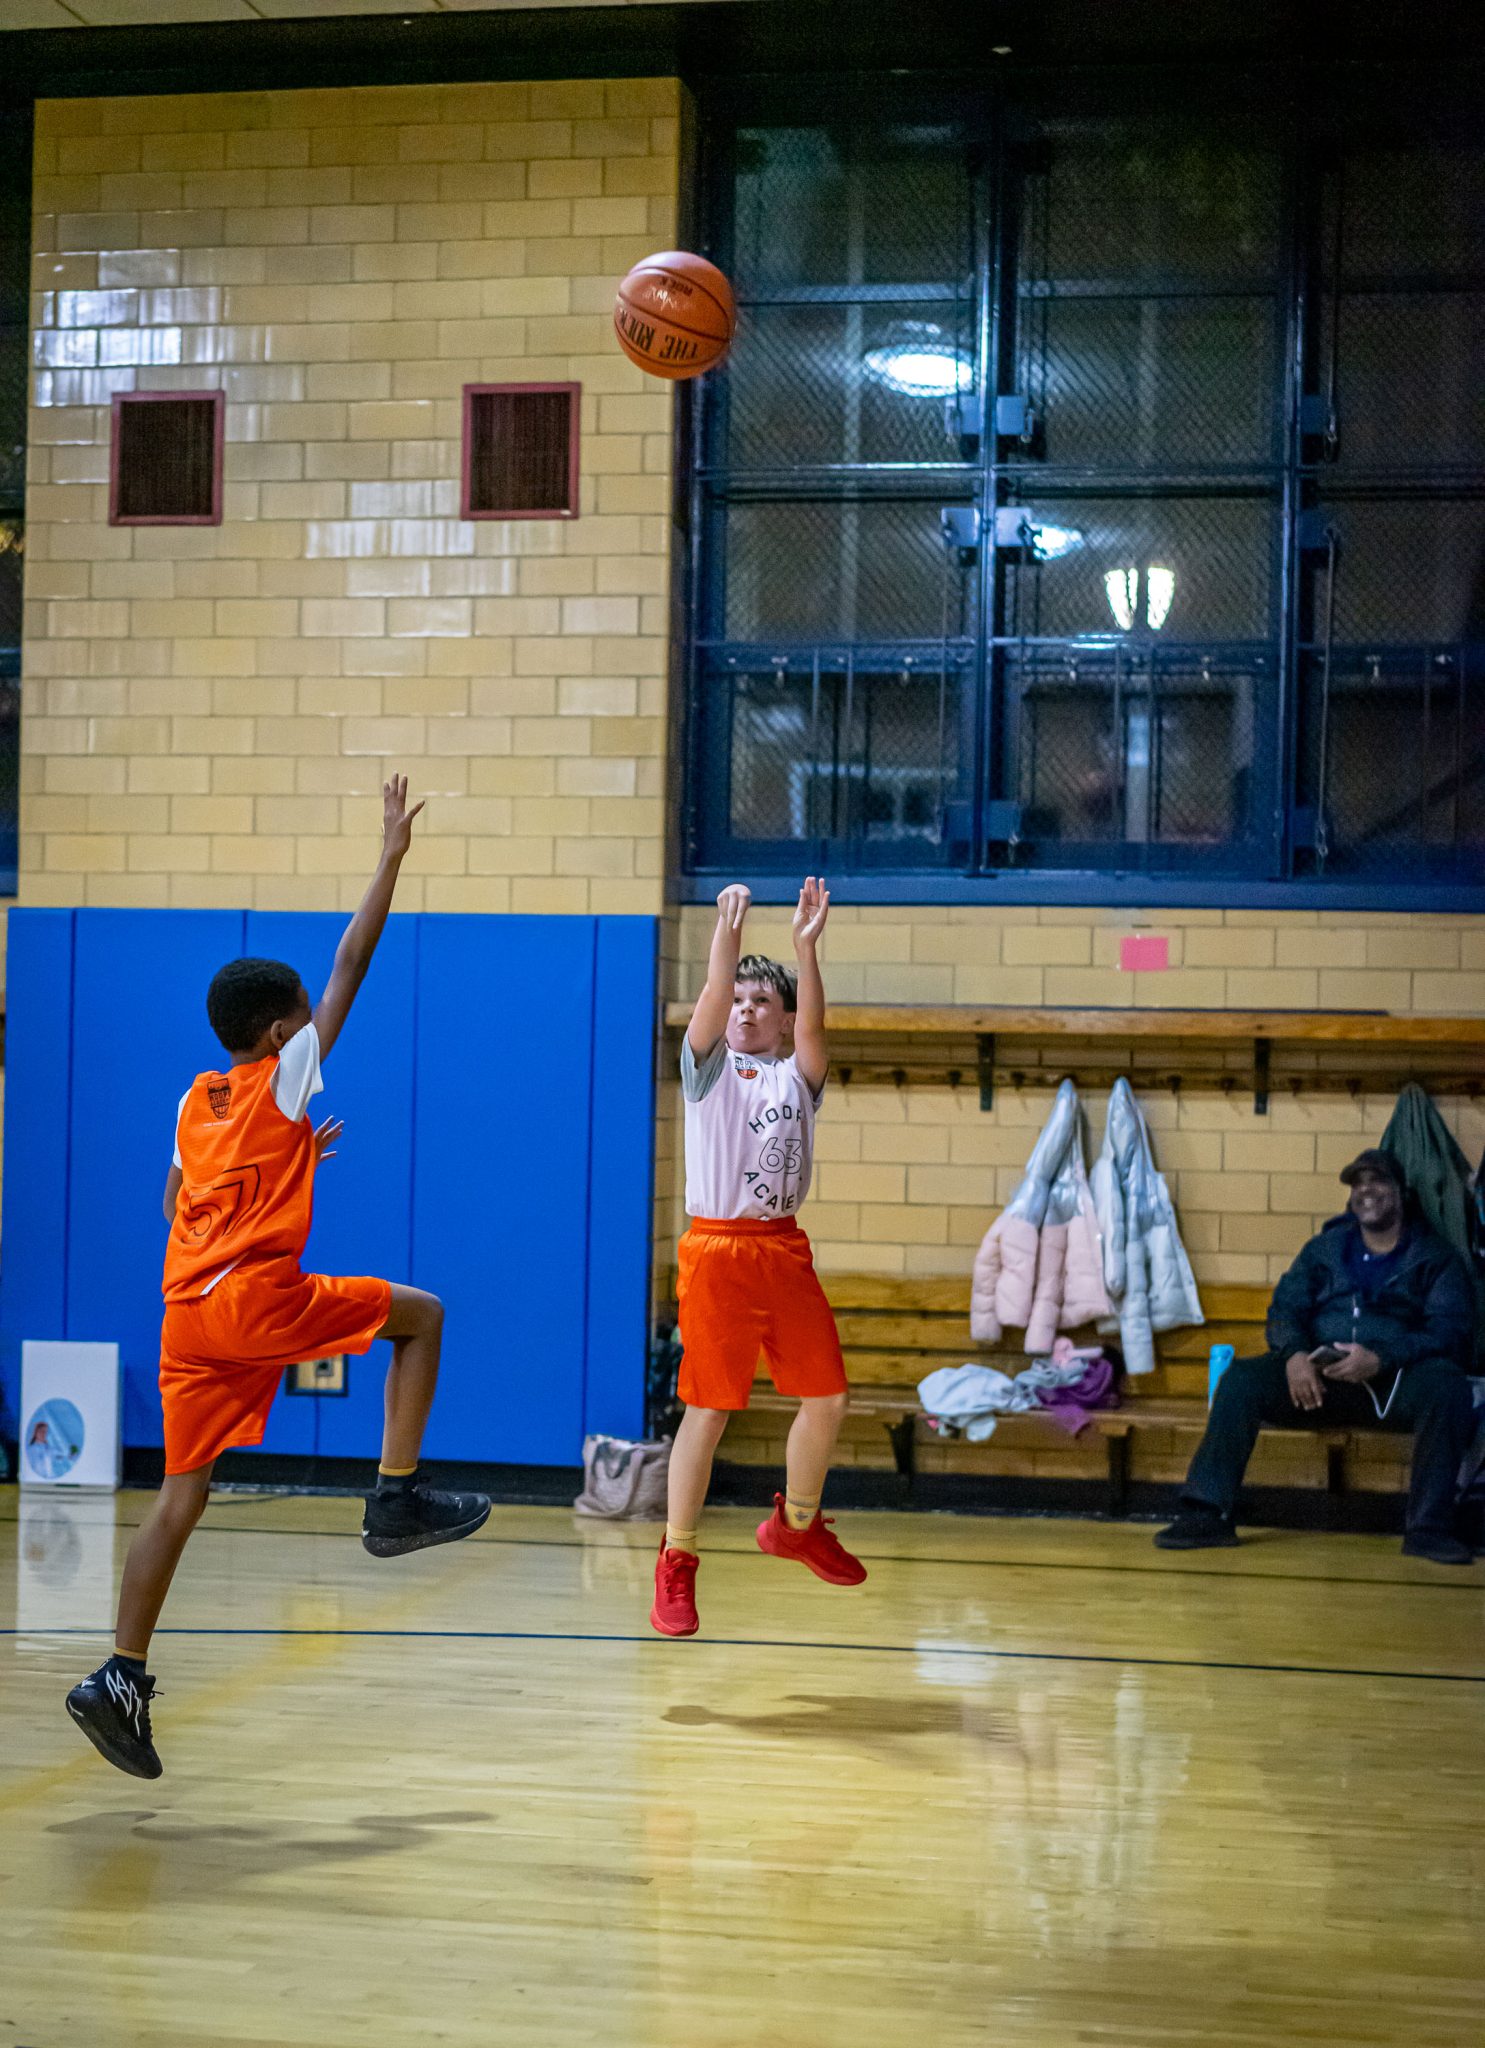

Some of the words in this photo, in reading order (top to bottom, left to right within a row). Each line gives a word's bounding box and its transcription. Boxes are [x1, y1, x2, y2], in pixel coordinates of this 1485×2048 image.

[659, 335, 698, 360] THE
[759, 1136, 802, 1175] 63
[180, 1163, 261, 1245] 57
